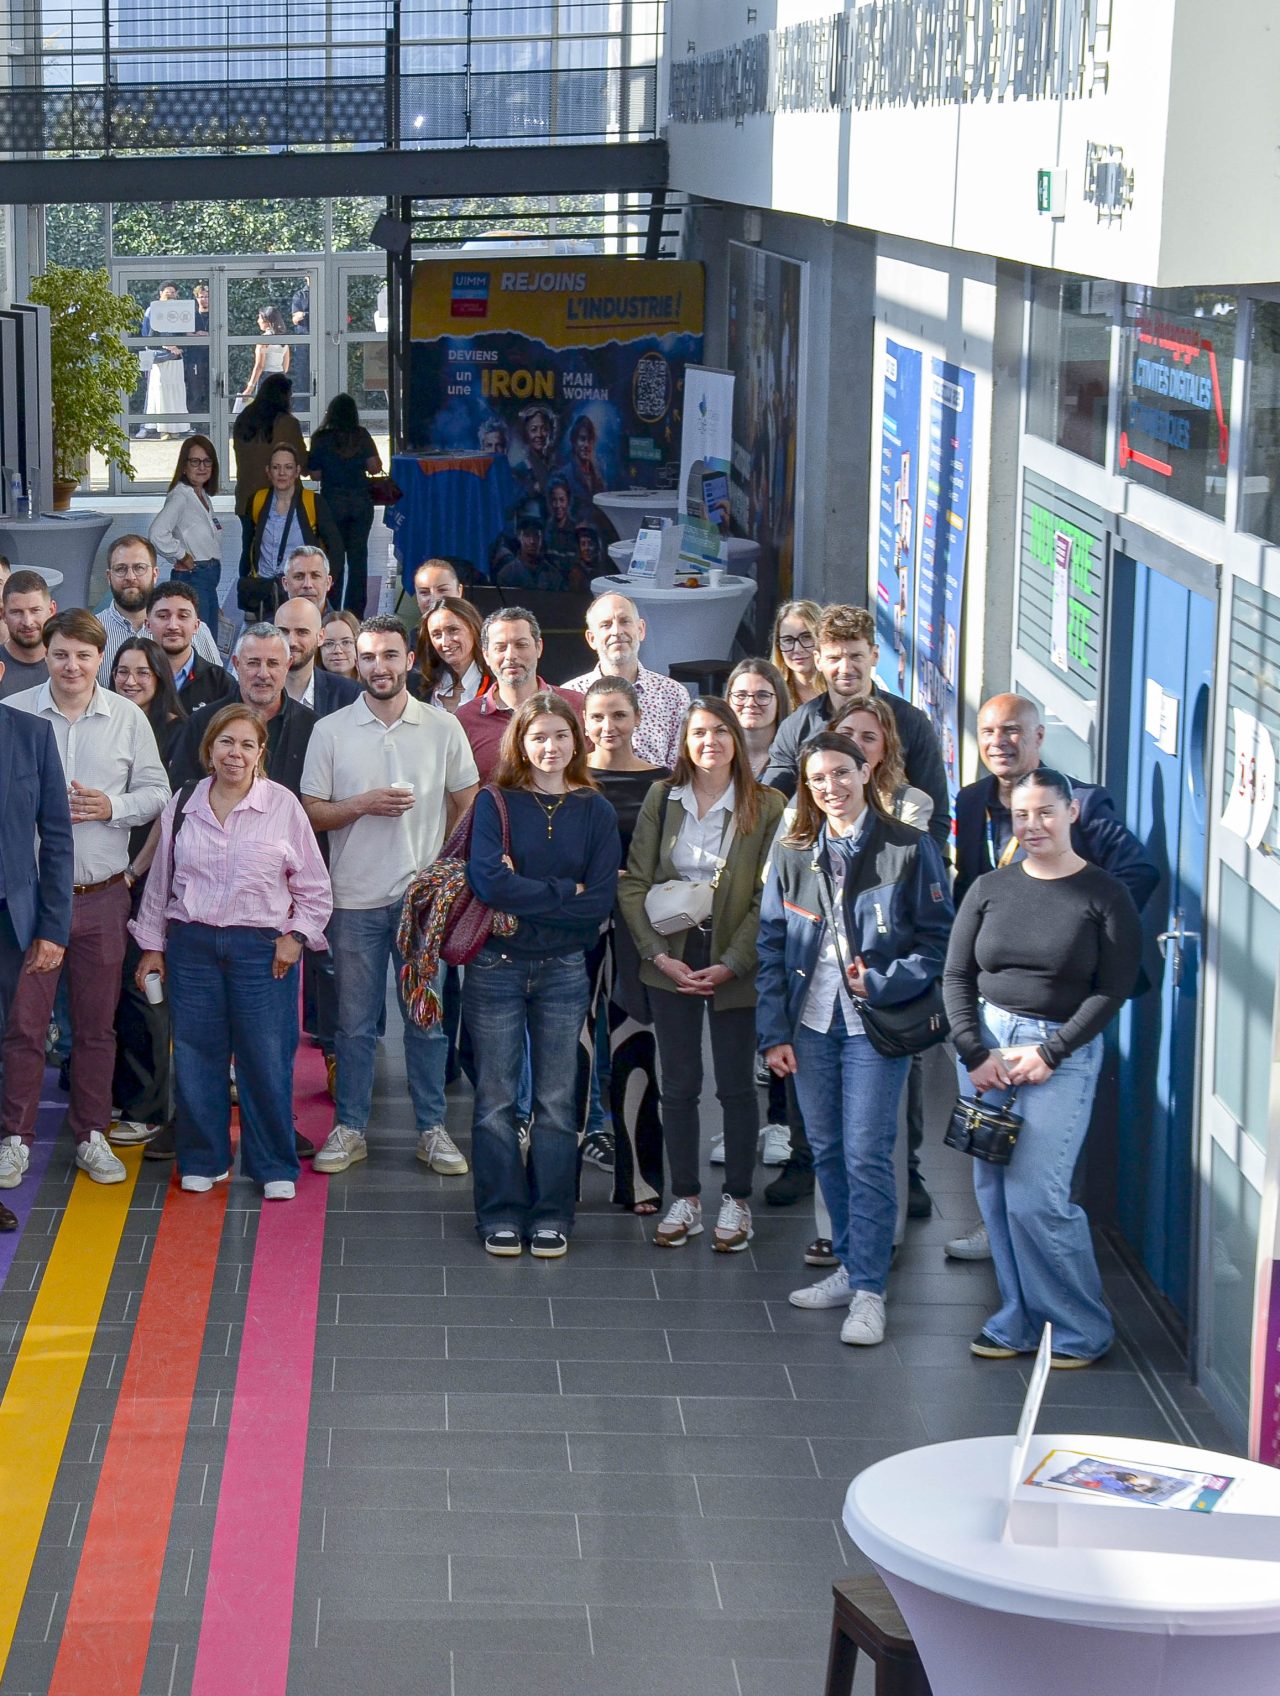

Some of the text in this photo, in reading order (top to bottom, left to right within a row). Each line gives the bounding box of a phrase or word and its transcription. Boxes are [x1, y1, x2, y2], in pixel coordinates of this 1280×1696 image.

[455, 275, 487, 287] UIMM
[500, 271, 587, 292] REJOINS
[448, 350, 498, 361] DEVIENS
[456, 369, 593, 398] un IRON MAN
[447, 385, 609, 401] une WOMAN
